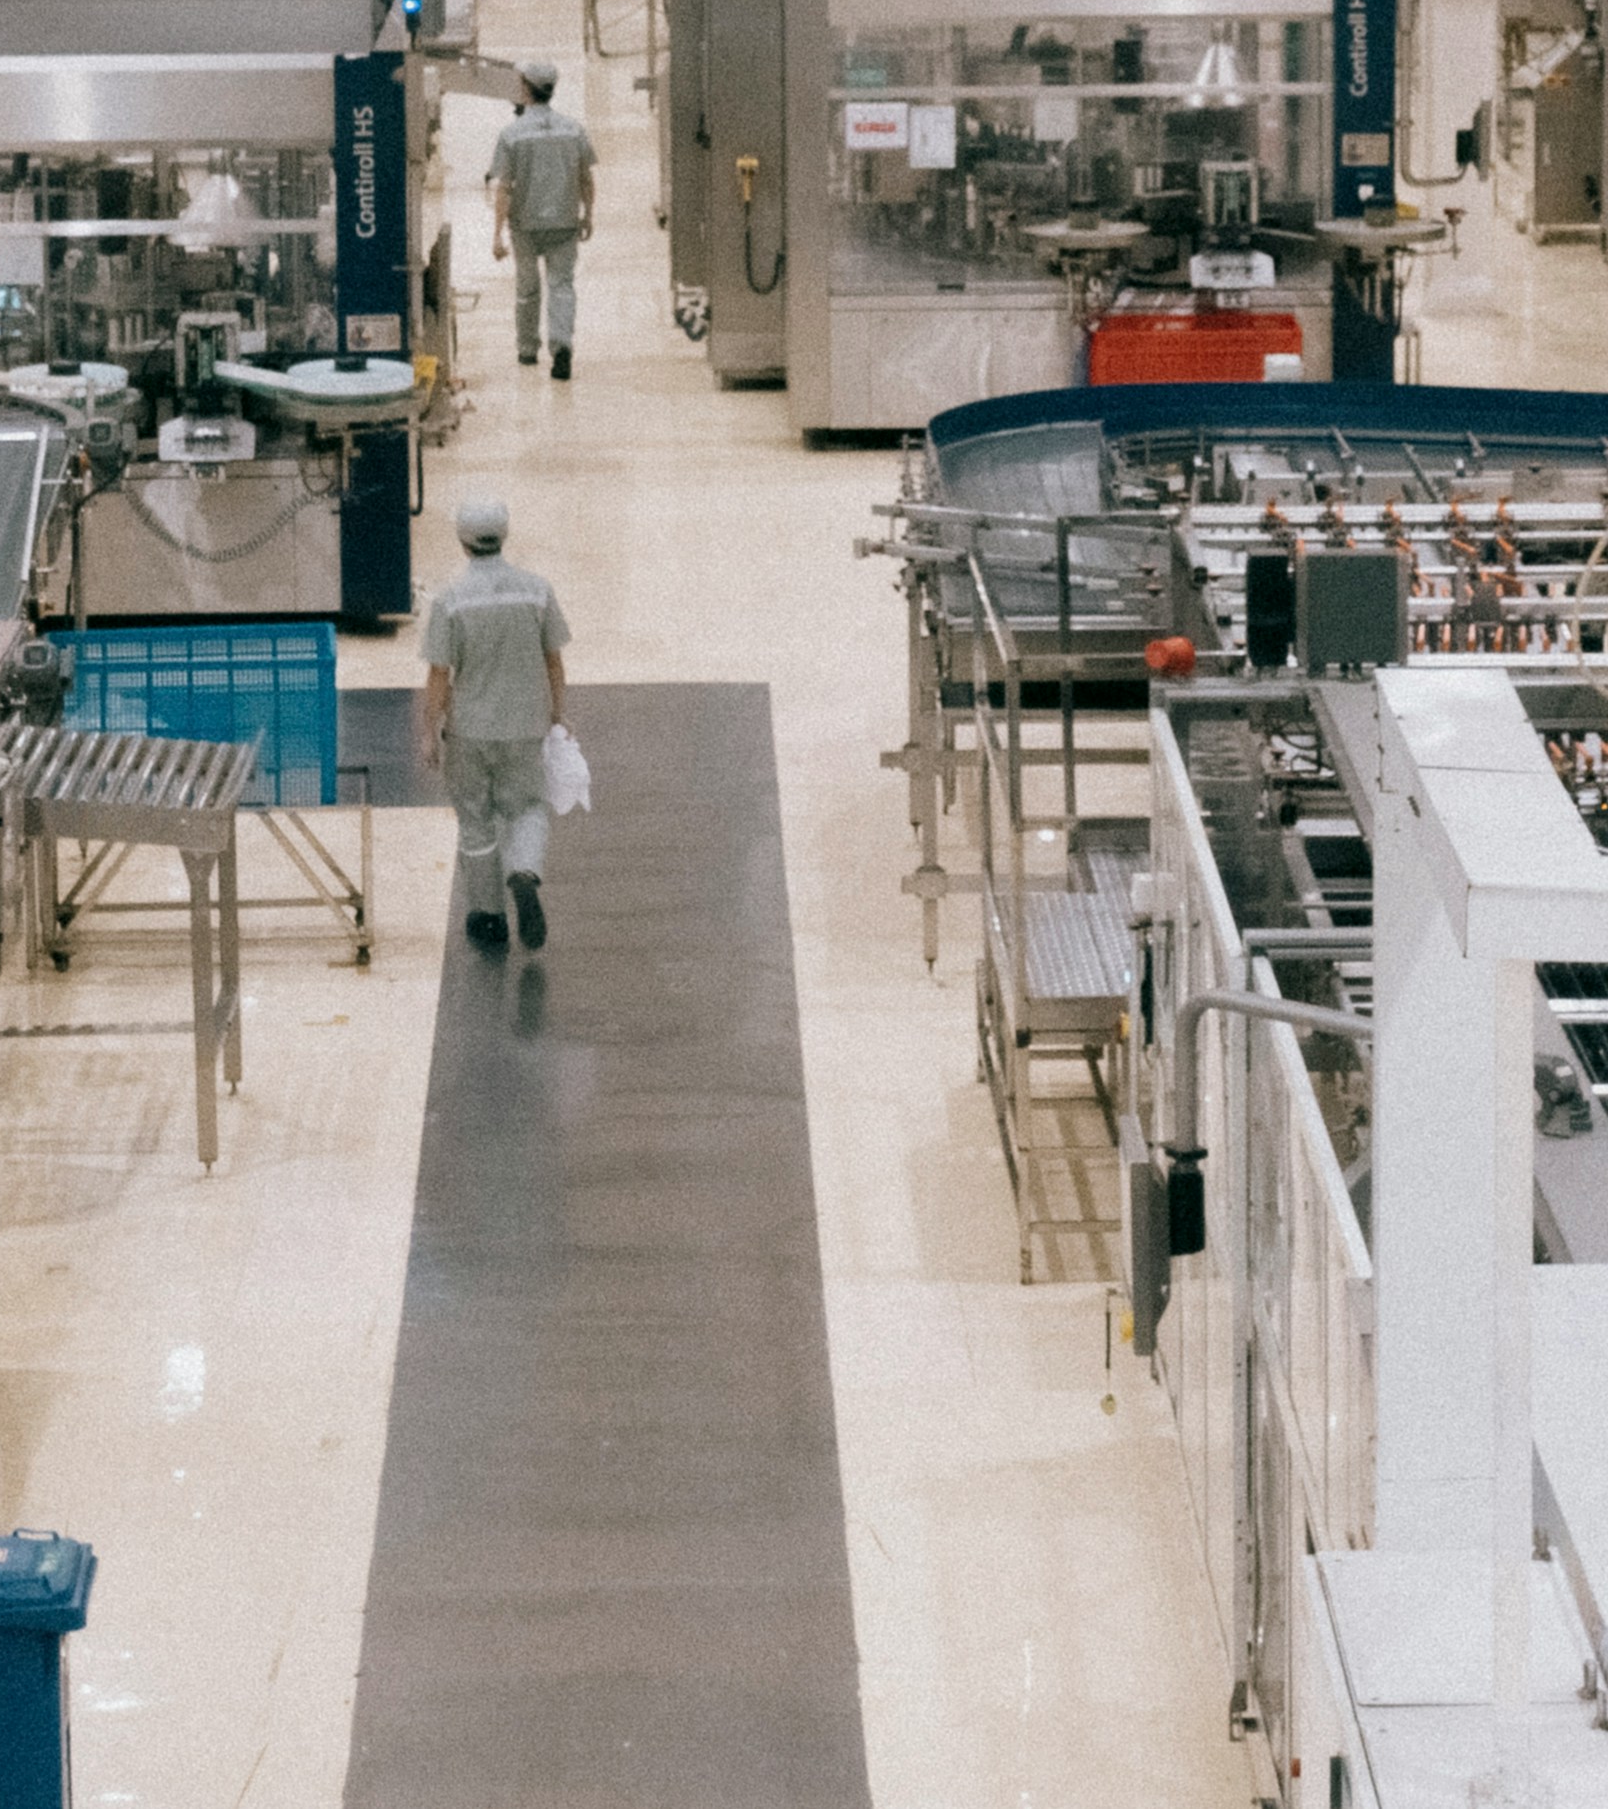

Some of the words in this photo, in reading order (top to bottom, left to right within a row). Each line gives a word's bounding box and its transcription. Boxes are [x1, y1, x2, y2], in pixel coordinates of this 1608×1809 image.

[1348, 14, 1368, 98] Contiroll
[353, 105, 374, 138] HS
[353, 142, 376, 239] Contiroll
